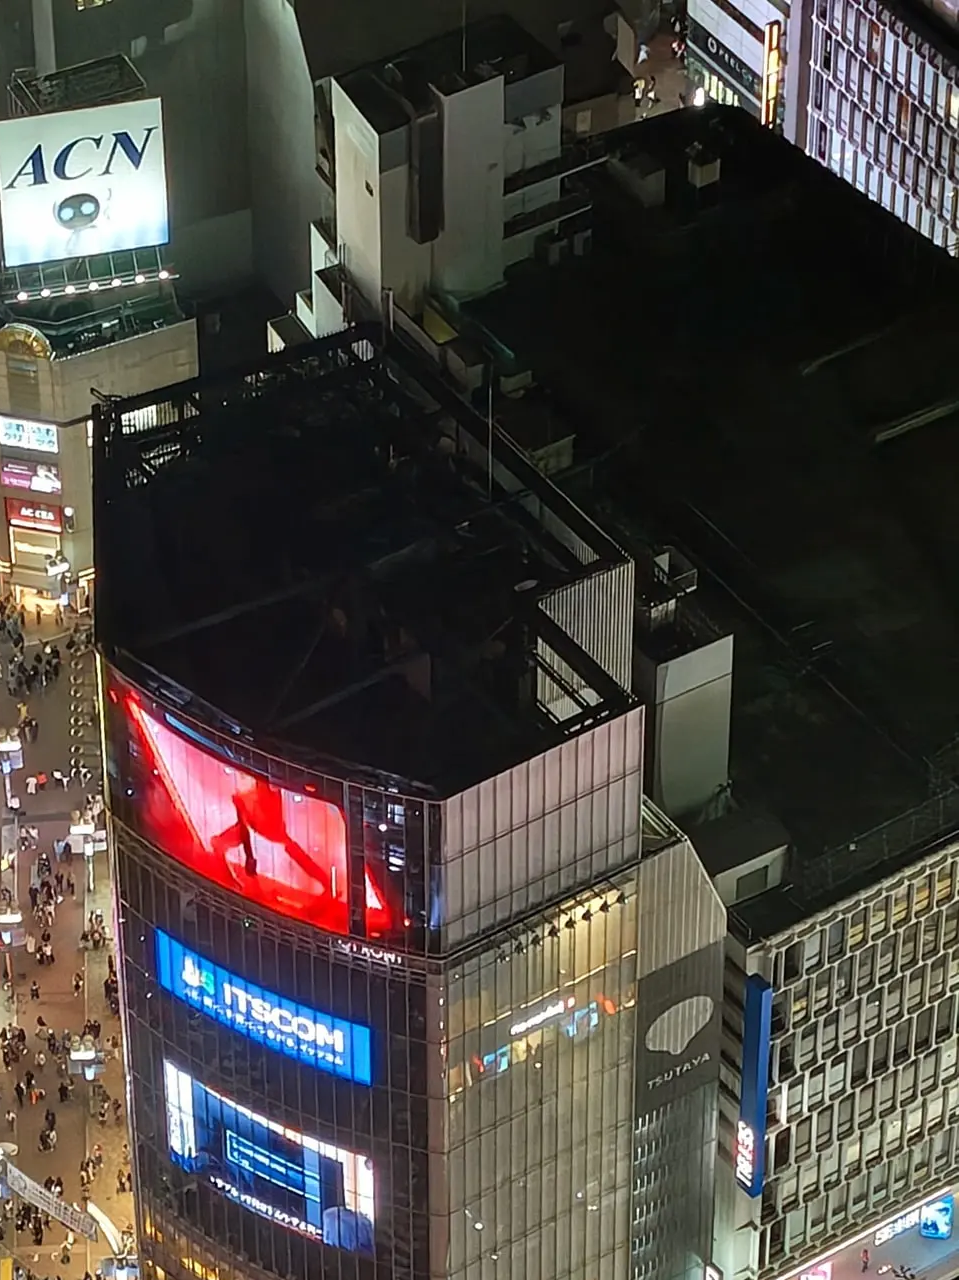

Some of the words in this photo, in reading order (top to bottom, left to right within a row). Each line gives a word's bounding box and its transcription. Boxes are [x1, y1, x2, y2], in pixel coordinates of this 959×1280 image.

[3, 126, 158, 190] ACN
[222, 982, 344, 1054] ITSCOM
[647, 1052, 712, 1091] TSUTAYA
